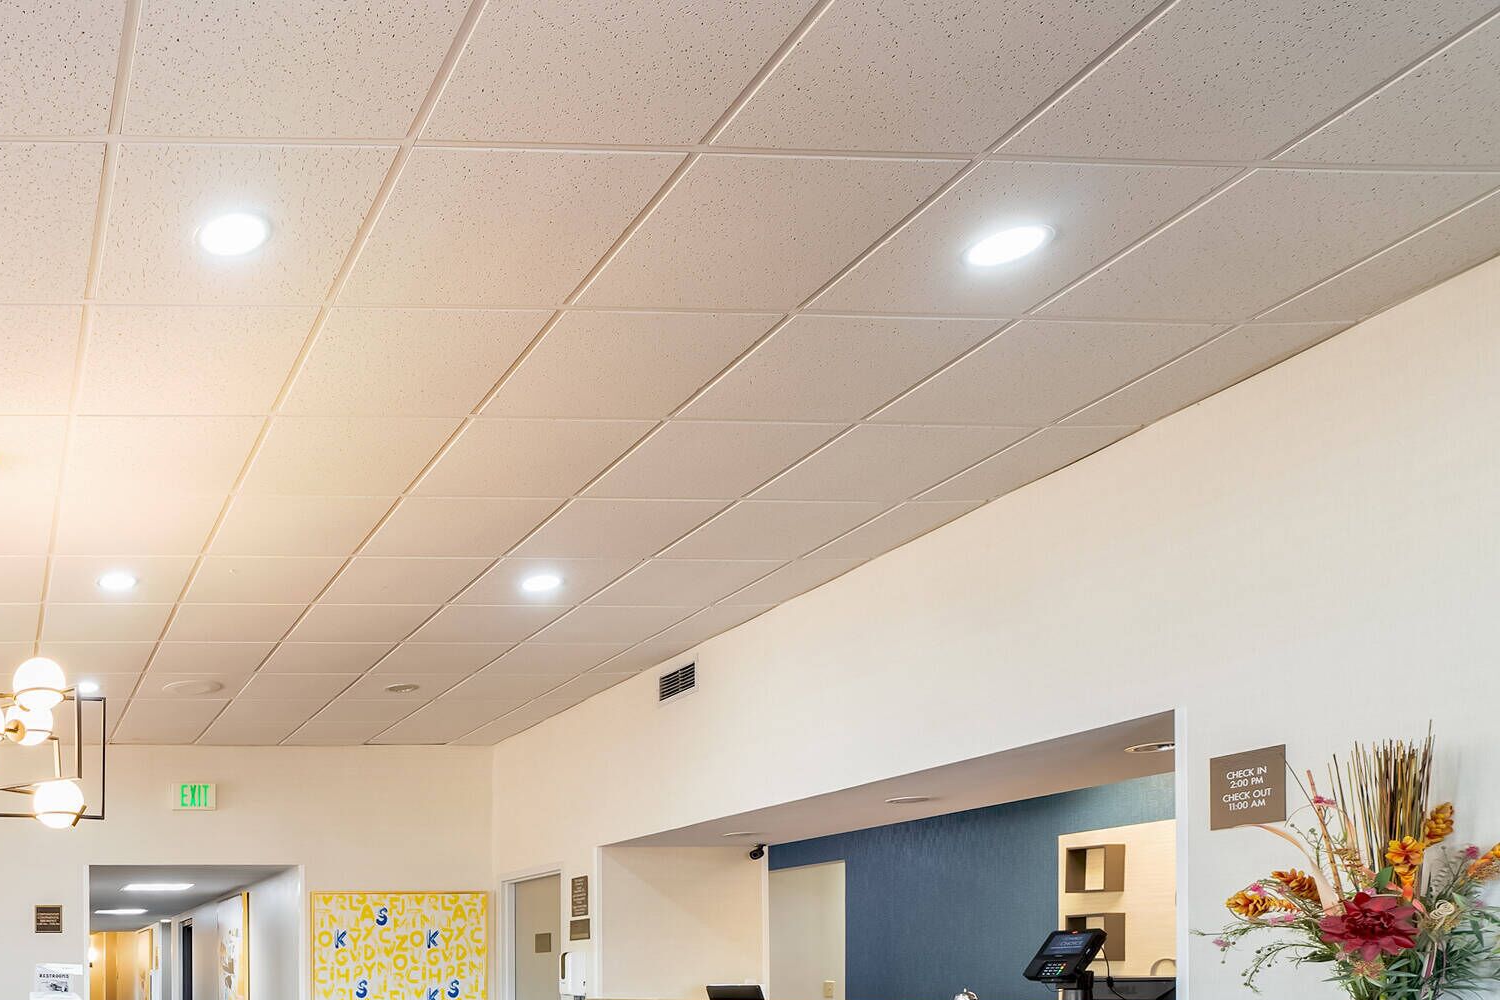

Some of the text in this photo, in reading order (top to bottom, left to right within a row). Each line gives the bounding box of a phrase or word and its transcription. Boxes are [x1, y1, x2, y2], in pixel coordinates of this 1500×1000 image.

[1226, 765, 1268, 780] CHECK IN
[1230, 776, 1263, 789] 2:00 PM
[180, 784, 209, 807] EXIT
[1222, 788, 1272, 803] CHECK OUT
[1229, 799, 1265, 811] 11:00 AM
